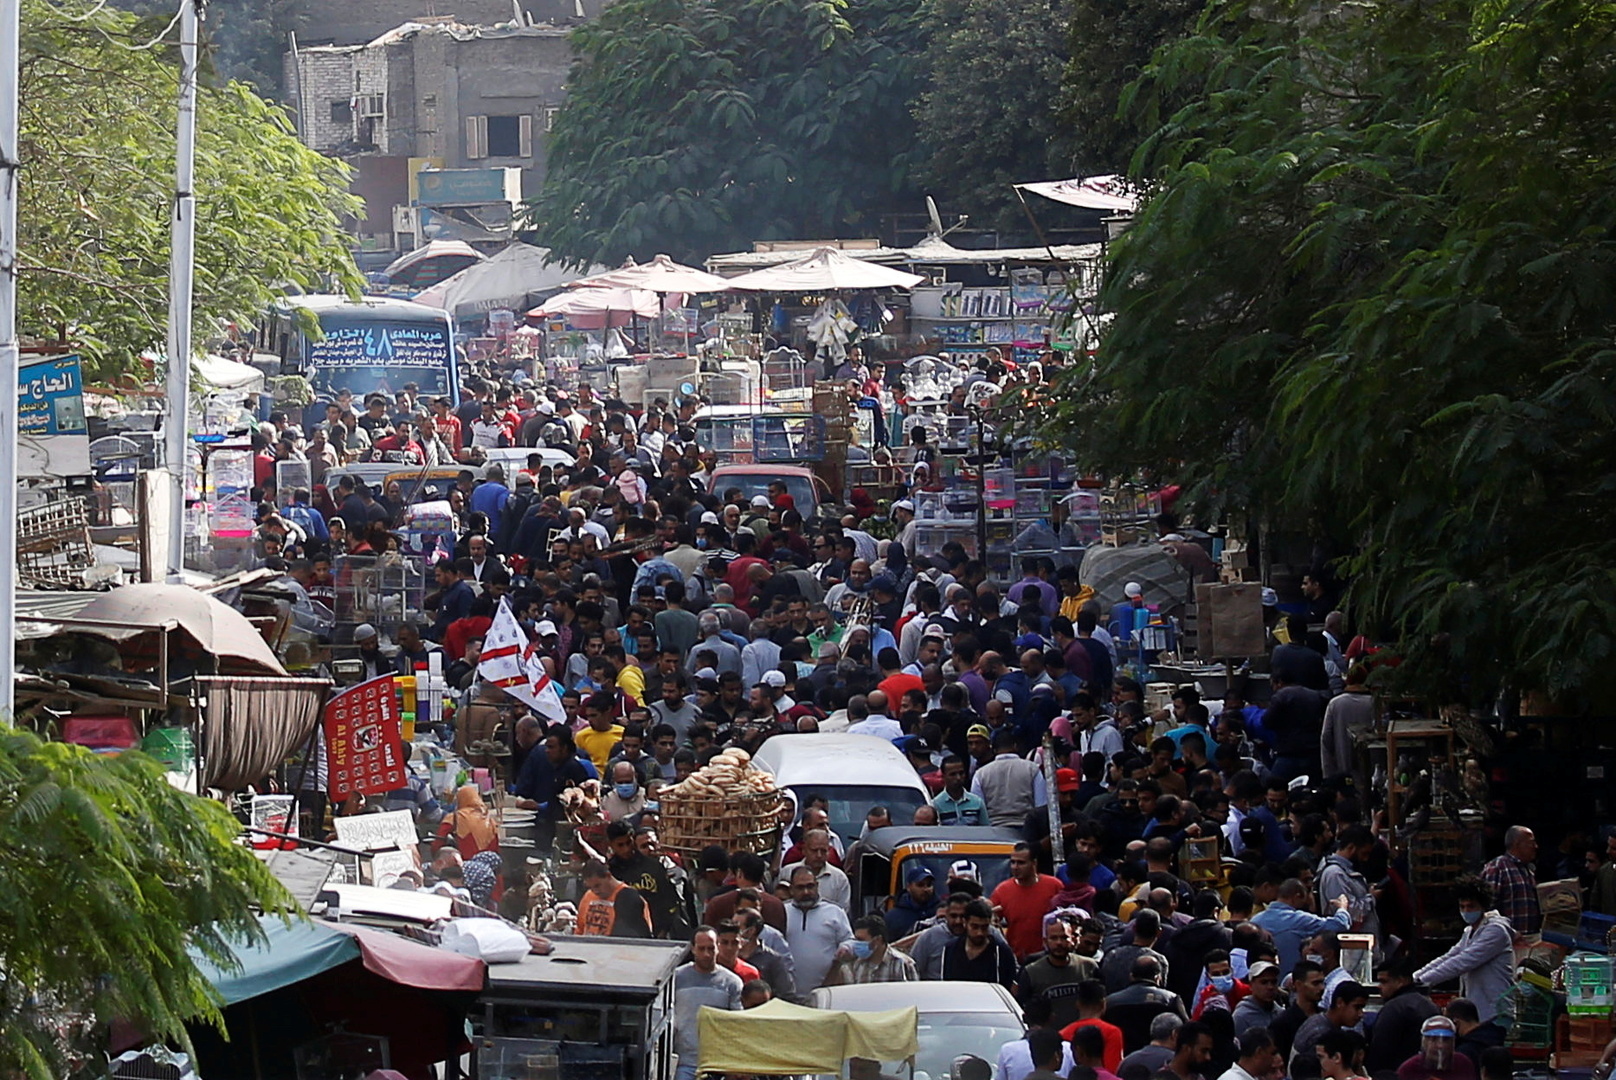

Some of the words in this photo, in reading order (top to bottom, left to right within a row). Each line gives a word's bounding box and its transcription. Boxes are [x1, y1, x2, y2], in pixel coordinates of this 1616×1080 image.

[364, 328, 393, 357] ٤٨
[31, 372, 73, 399] الحاج
[381, 697, 390, 720] القرن
[337, 725, 346, 736] Al
[337, 740, 346, 765] Ahly
[385, 744, 395, 767] نادي
